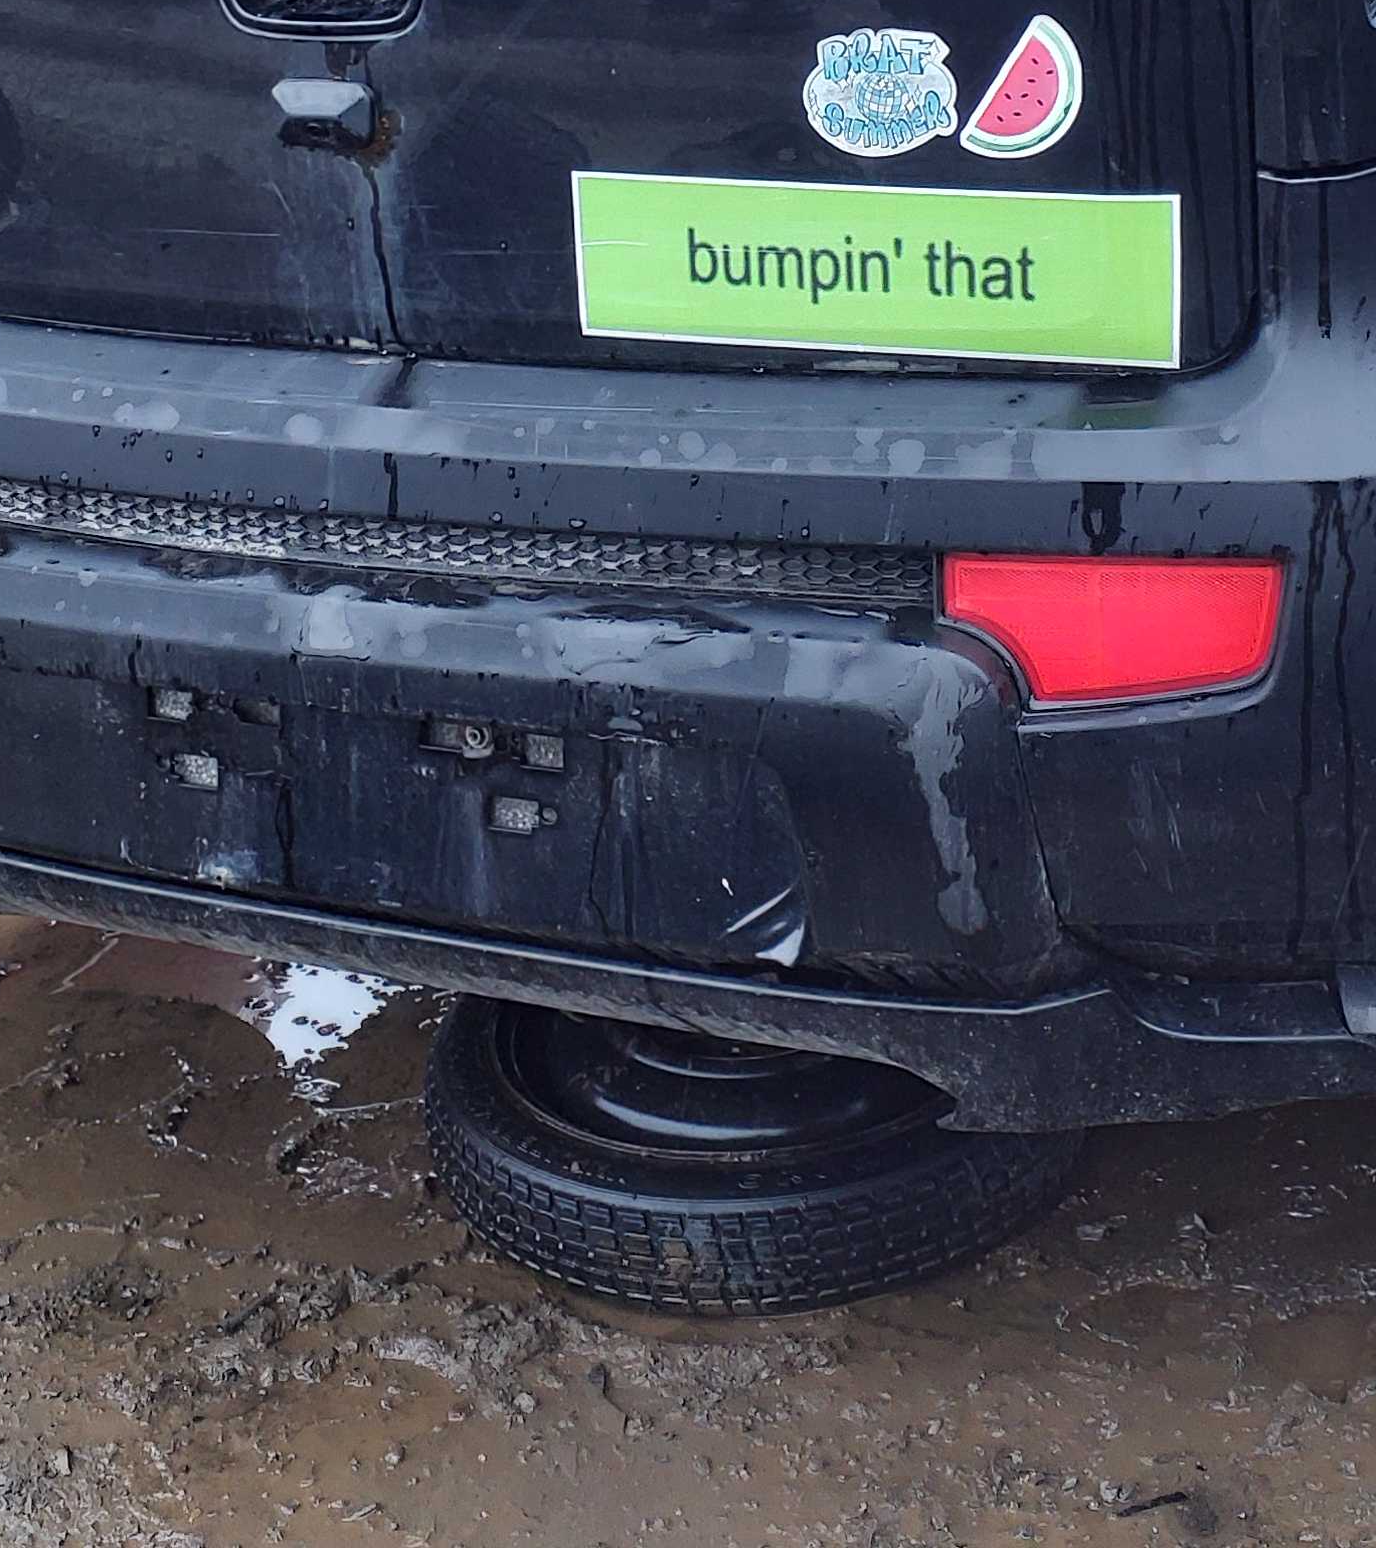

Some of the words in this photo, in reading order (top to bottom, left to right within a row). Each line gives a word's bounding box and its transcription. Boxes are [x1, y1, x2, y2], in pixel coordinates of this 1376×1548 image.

[824, 33, 932, 79] BRAT
[822, 91, 950, 149] SUMMER
[688, 227, 902, 304] bumpin'
[924, 240, 1036, 301] that
